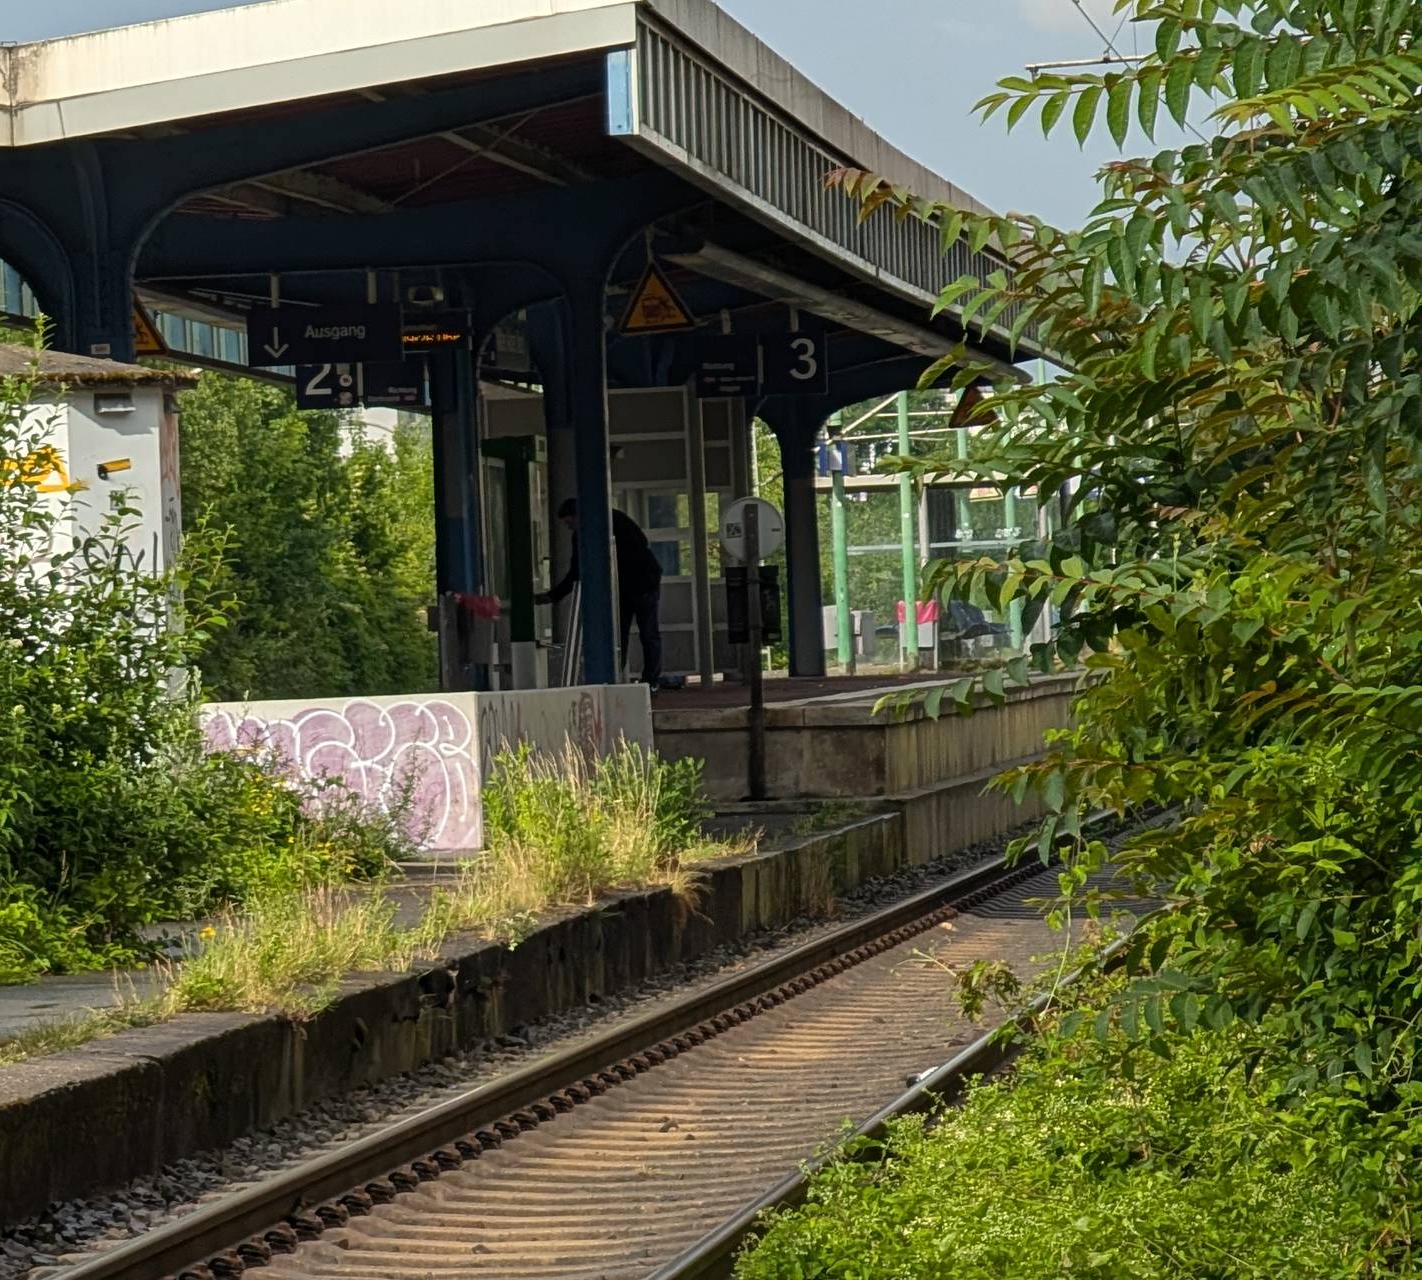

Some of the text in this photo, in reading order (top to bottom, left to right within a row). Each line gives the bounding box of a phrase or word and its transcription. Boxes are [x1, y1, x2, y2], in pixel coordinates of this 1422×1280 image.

[304, 324, 366, 340] Ausgang
[789, 338, 817, 380] 3
[305, 363, 332, 395] 2
